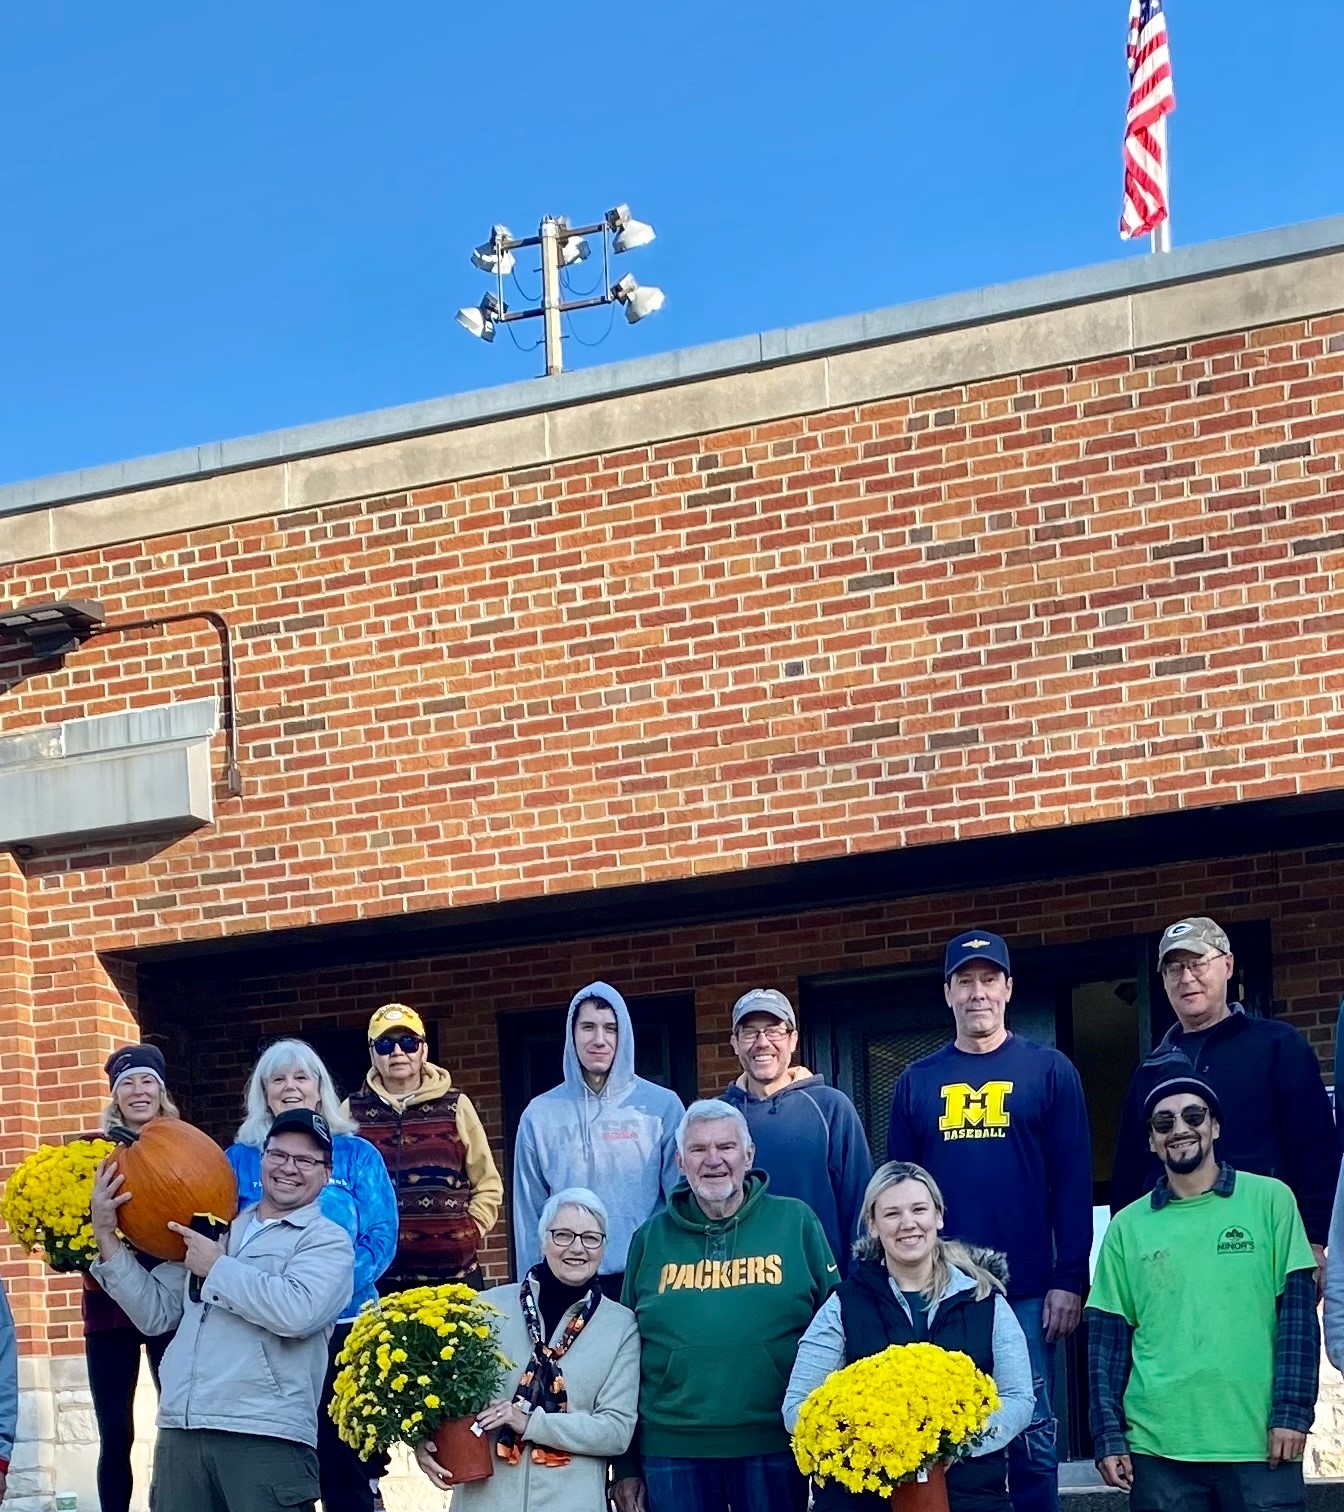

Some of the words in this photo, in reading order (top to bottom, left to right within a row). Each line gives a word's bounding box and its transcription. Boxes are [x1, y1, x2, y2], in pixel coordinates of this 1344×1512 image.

[939, 1081, 1013, 1130] M
[944, 1127, 1005, 1141] BASEBALL
[1217, 1241, 1254, 1250] MINOR'S
[658, 1254, 782, 1294] PACKERS
